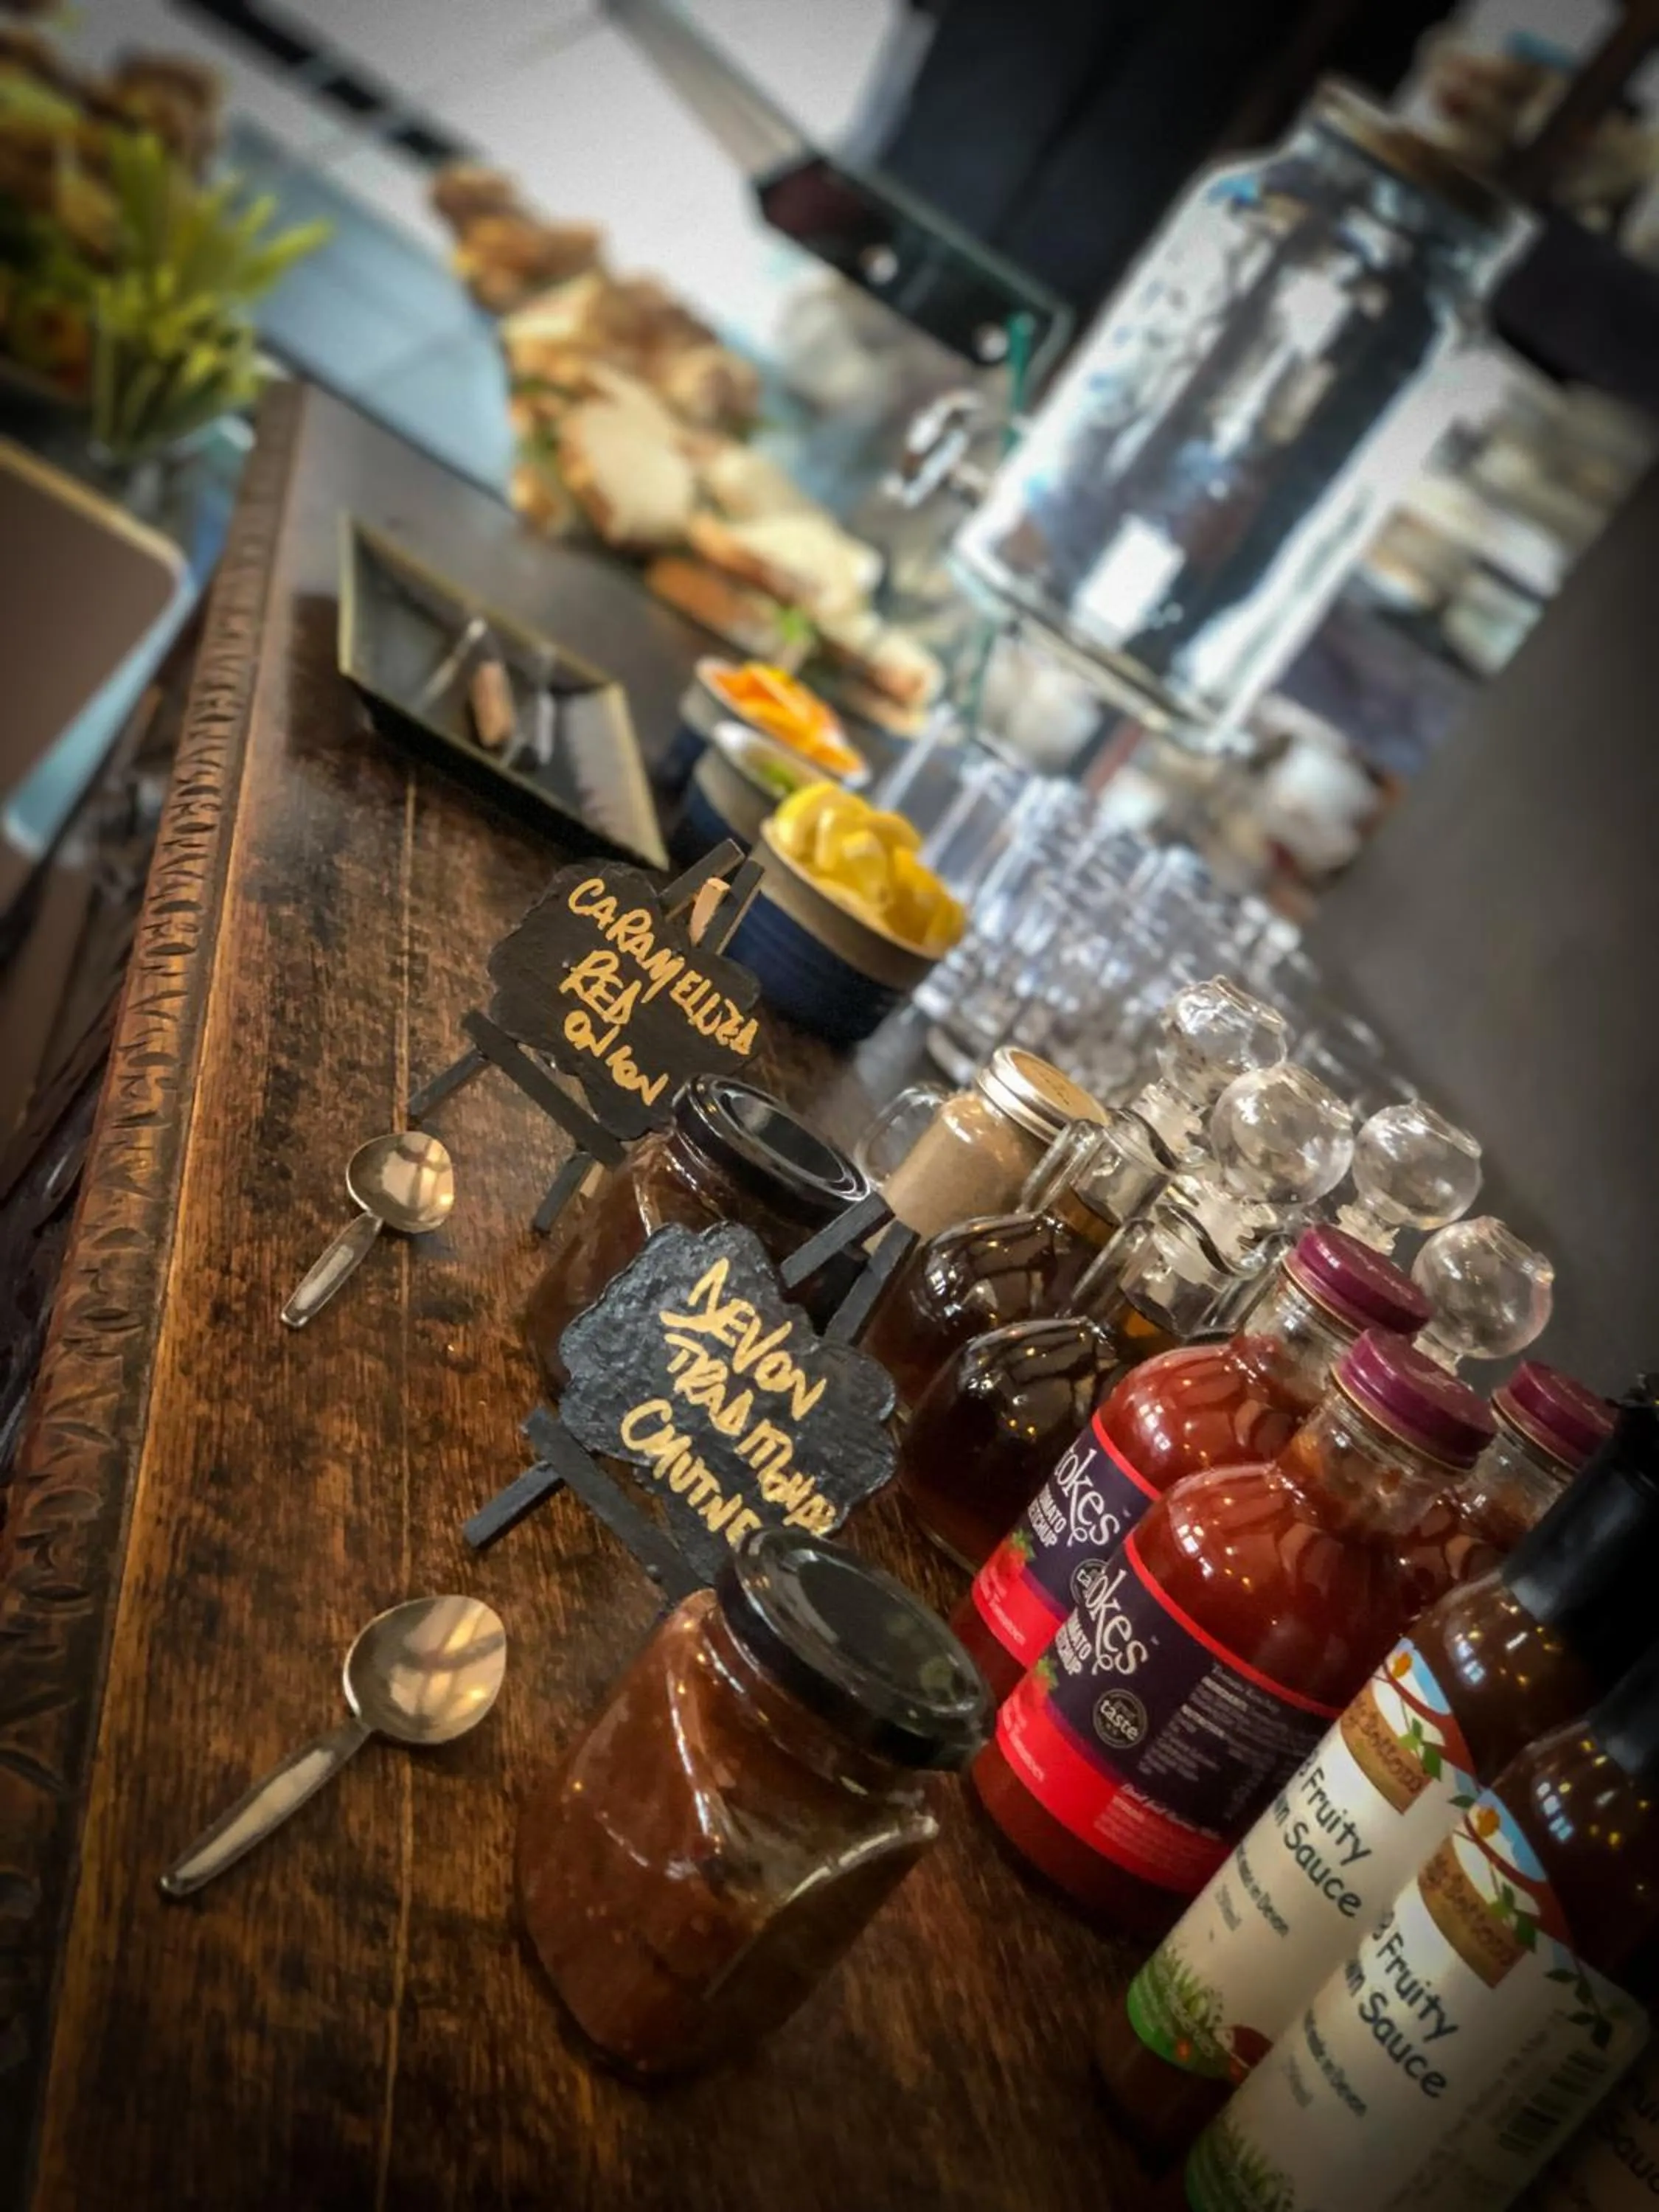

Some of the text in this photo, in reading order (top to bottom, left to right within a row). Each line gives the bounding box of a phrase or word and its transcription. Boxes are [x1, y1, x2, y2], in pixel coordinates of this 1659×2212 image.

[560, 950, 642, 1024] RED
[659, 1257, 827, 1421] DEVON
[1100, 1700, 1138, 1741] taste
[1301, 1767, 1372, 1866] Fruity
[1284, 1822, 1362, 1919] Sauce
[1377, 1932, 1459, 2043] Fruity
[1359, 1992, 1447, 2099] Sauce
